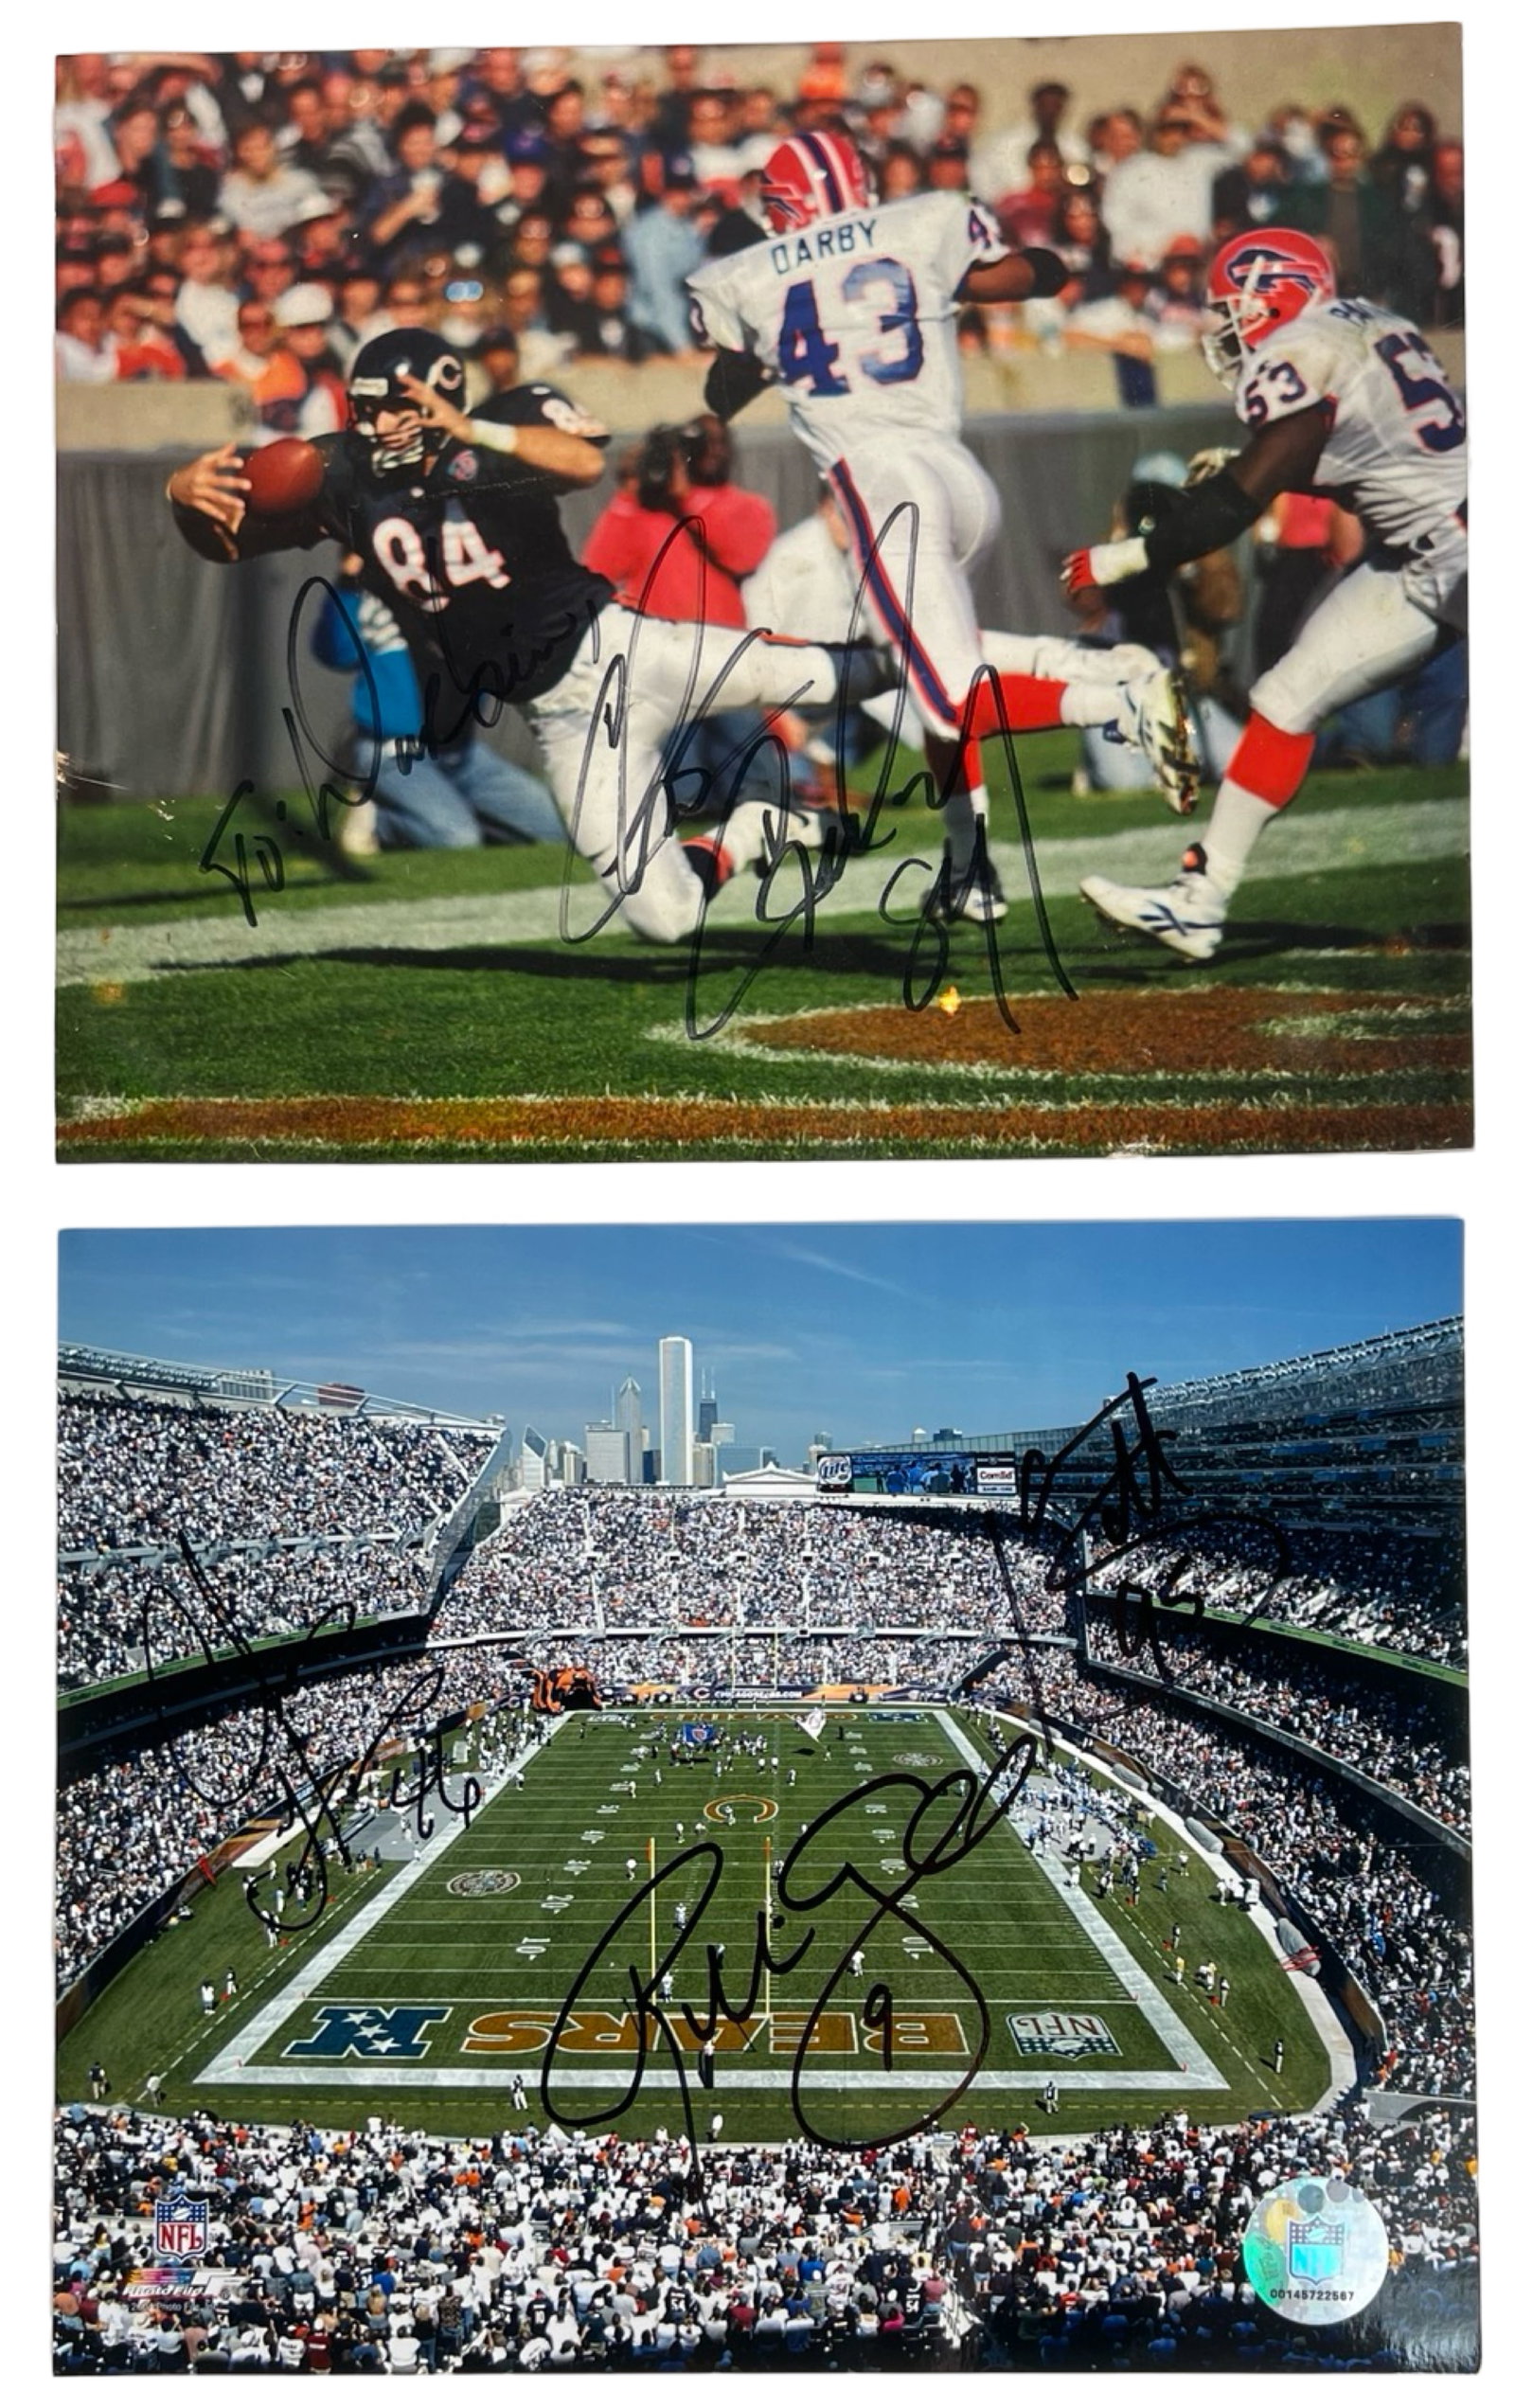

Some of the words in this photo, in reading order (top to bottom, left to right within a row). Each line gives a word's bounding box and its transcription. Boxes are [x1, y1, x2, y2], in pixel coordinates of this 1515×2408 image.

[770, 218, 877, 276] DARBY
[777, 257, 924, 398] 43
[1244, 360, 1308, 426] 53
[372, 517, 512, 613] 84
[459, 2010, 971, 2055] BEARS
[864, 1982, 893, 2072] 9
[1016, 2013, 1100, 2037] NFL
[160, 2223, 204, 2253] NFL
